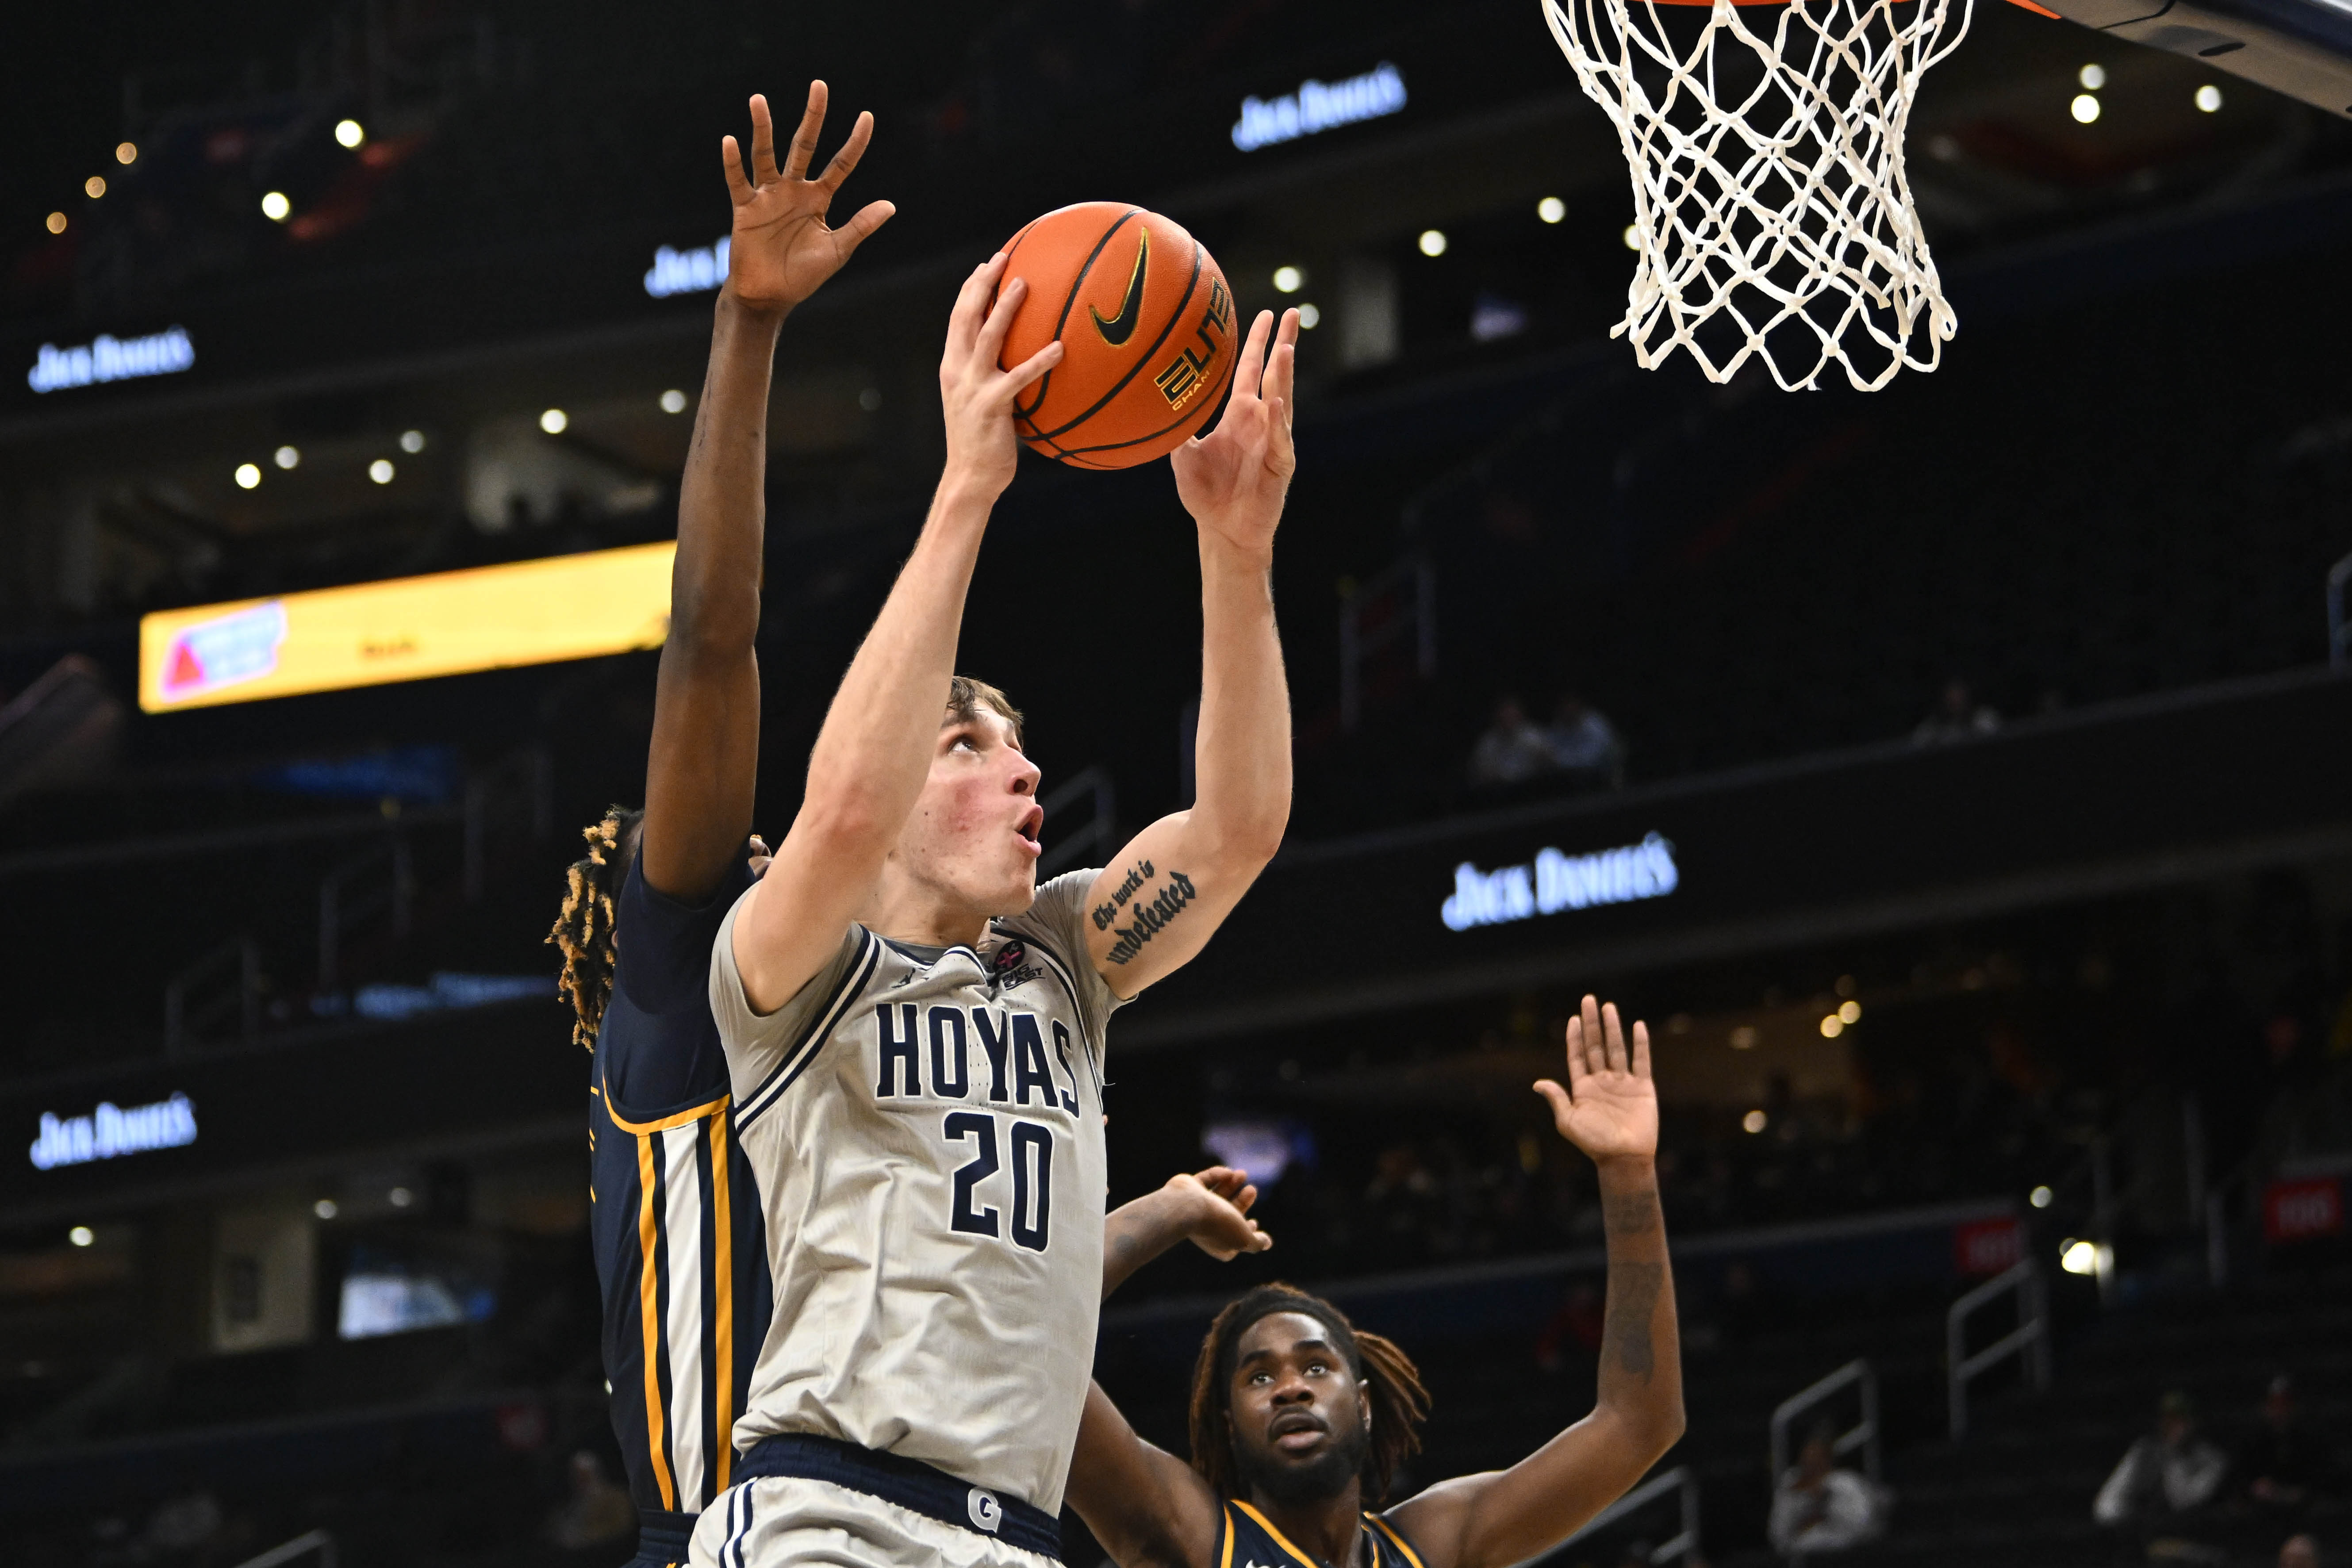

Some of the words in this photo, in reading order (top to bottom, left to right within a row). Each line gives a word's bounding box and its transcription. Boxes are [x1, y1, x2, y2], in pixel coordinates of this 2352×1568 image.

[1154, 276, 1230, 404] ELITE
[1093, 902, 1117, 931] The
[1112, 868, 1144, 907] work
[1138, 859, 1155, 878] is
[1106, 871, 1195, 965] undefeated
[874, 1001, 1080, 1119] HOYAS
[942, 1108, 1055, 1255] 20
[967, 1487, 1001, 1533] G
